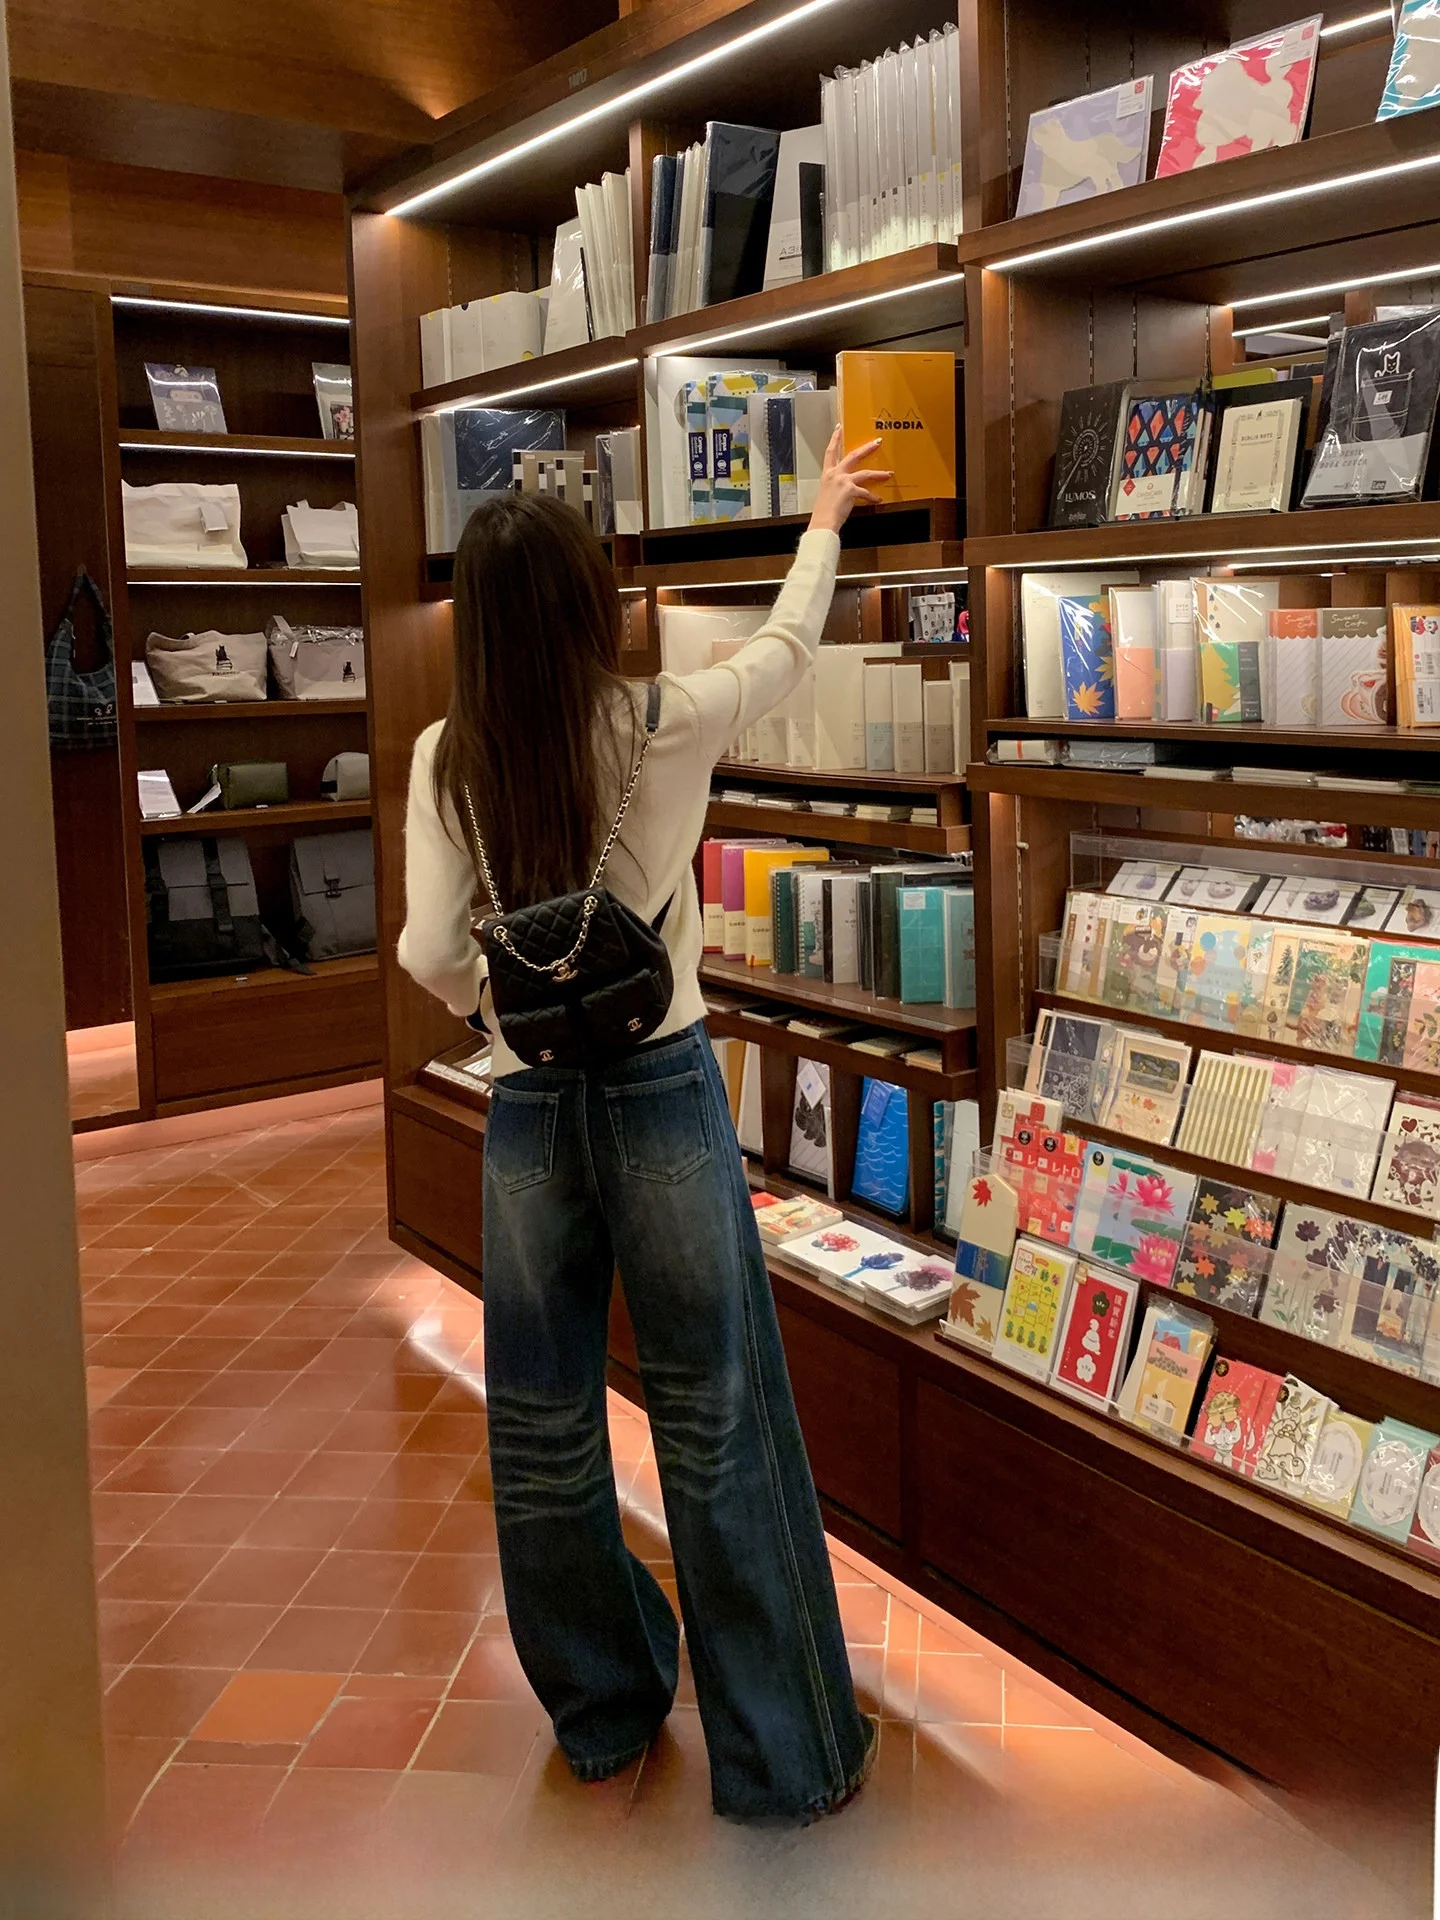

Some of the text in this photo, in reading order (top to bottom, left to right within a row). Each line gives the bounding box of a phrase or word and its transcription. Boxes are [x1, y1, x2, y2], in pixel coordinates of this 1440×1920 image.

[875, 420, 924, 430] RHODIA
[1065, 490, 1096, 503] LUMOS
[1051, 1161, 1081, 1179] レトロ
